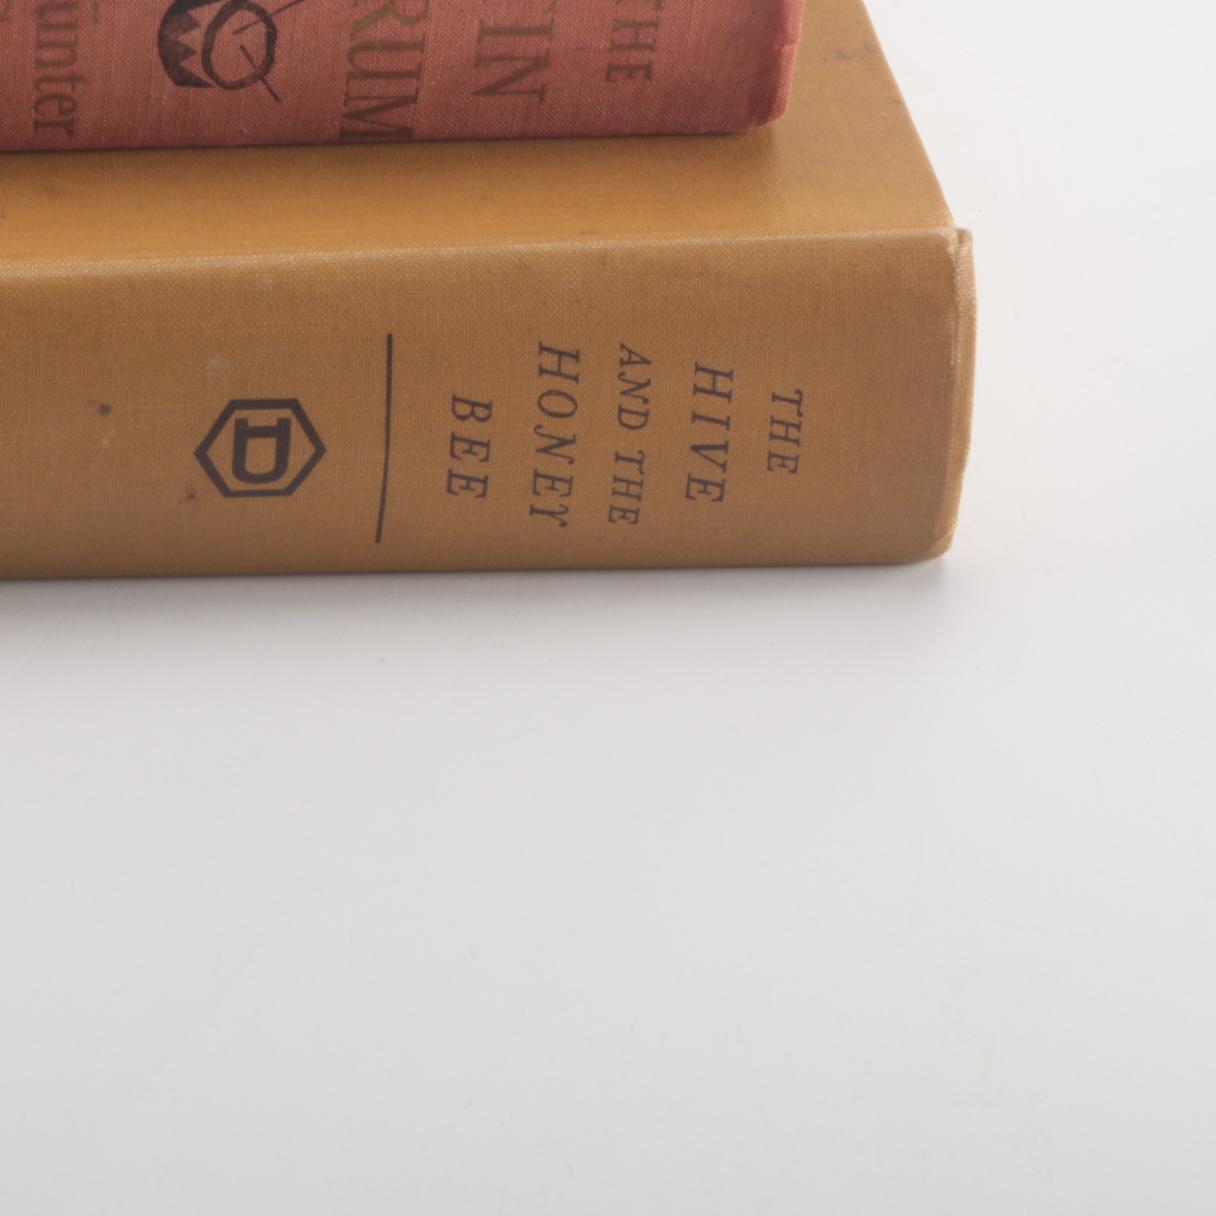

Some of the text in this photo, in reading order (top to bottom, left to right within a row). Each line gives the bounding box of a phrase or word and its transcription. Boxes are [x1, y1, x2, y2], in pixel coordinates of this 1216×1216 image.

[231, 417, 292, 485] D
[445, 393, 493, 499] BEE
[528, 340, 581, 528] HONEY
[607, 342, 652, 526] AND THE
[684, 361, 734, 503] HIVE
[767, 388, 804, 475] THE
